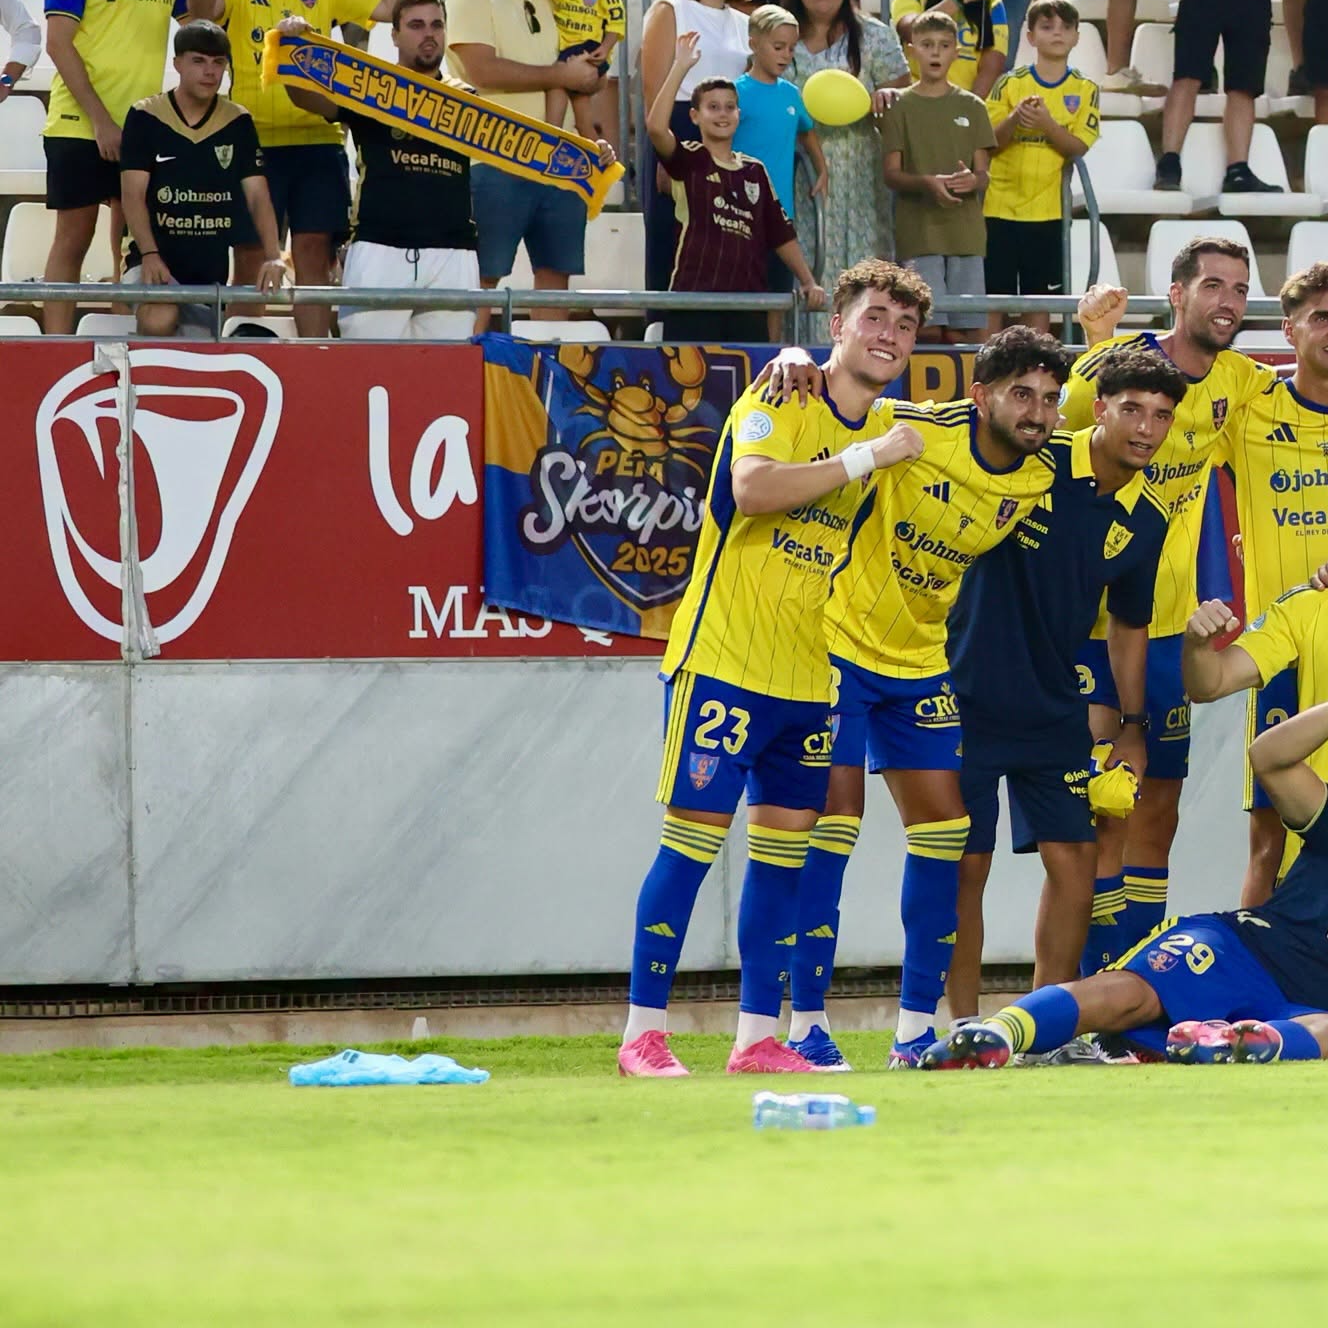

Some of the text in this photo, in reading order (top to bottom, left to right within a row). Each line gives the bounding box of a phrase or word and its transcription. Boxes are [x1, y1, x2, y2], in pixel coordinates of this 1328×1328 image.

[405, 76, 544, 165] ORIHUELA
[174, 190, 232, 204] johnson
[368, 385, 478, 536] la
[612, 541, 691, 576] 2025
[695, 700, 751, 755] 23
[650, 961, 668, 975] 23
[1166, 933, 1216, 975] 29
